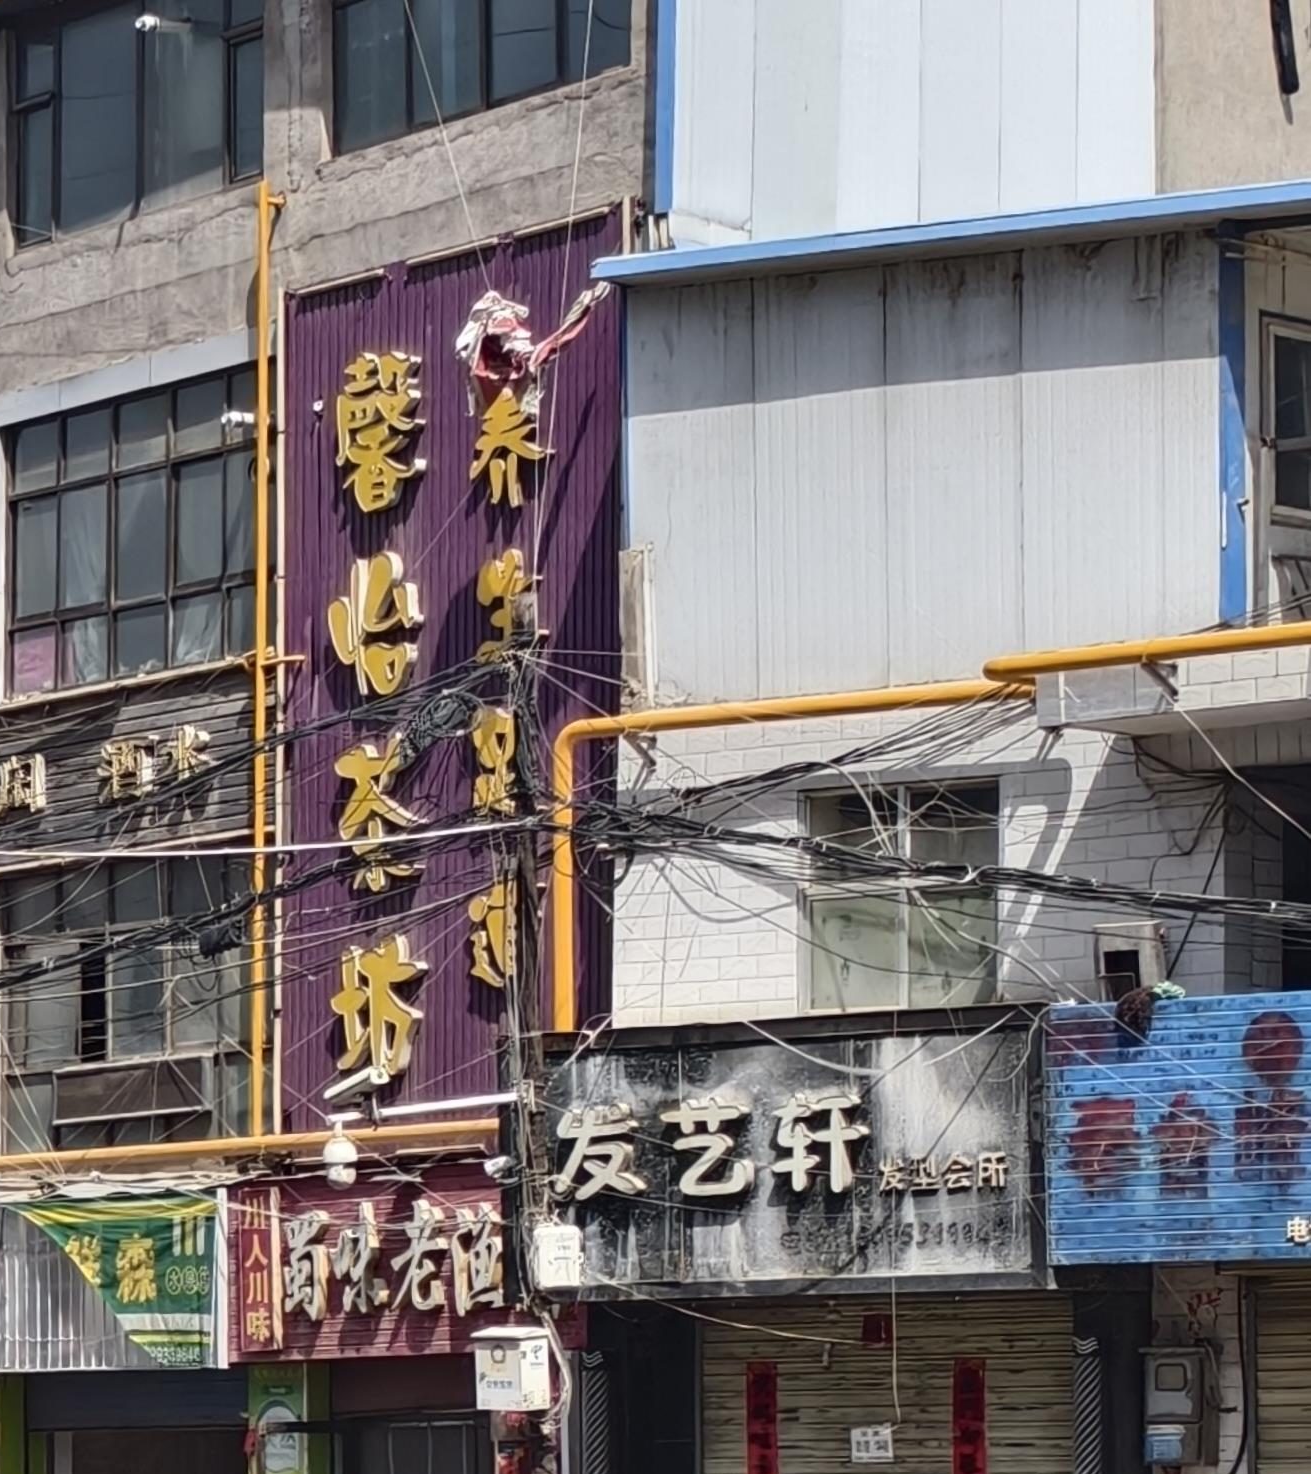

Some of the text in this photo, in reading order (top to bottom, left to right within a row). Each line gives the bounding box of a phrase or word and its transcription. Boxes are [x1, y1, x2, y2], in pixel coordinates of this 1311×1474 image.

[553, 1092, 871, 1200] 发艺轩
[879, 1150, 1009, 1193] 发型会所
